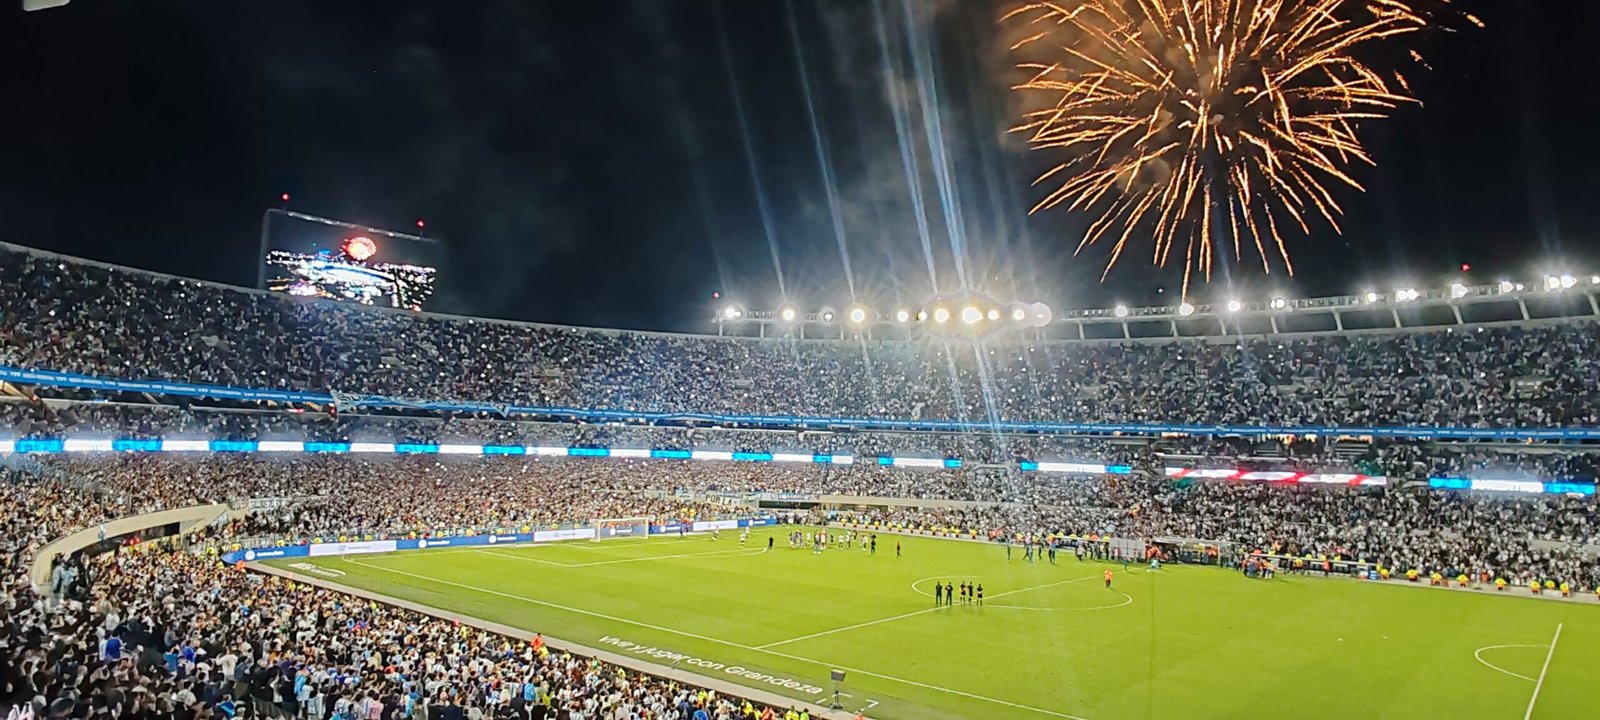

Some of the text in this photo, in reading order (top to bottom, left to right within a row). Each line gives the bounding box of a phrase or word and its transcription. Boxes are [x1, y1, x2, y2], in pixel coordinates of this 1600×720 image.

[705, 494, 732, 506] POR LA
[598, 636, 635, 648] Vivir
[634, 646, 690, 660] jugar
[687, 658, 725, 670] con
[725, 666, 823, 694] Grandeza
